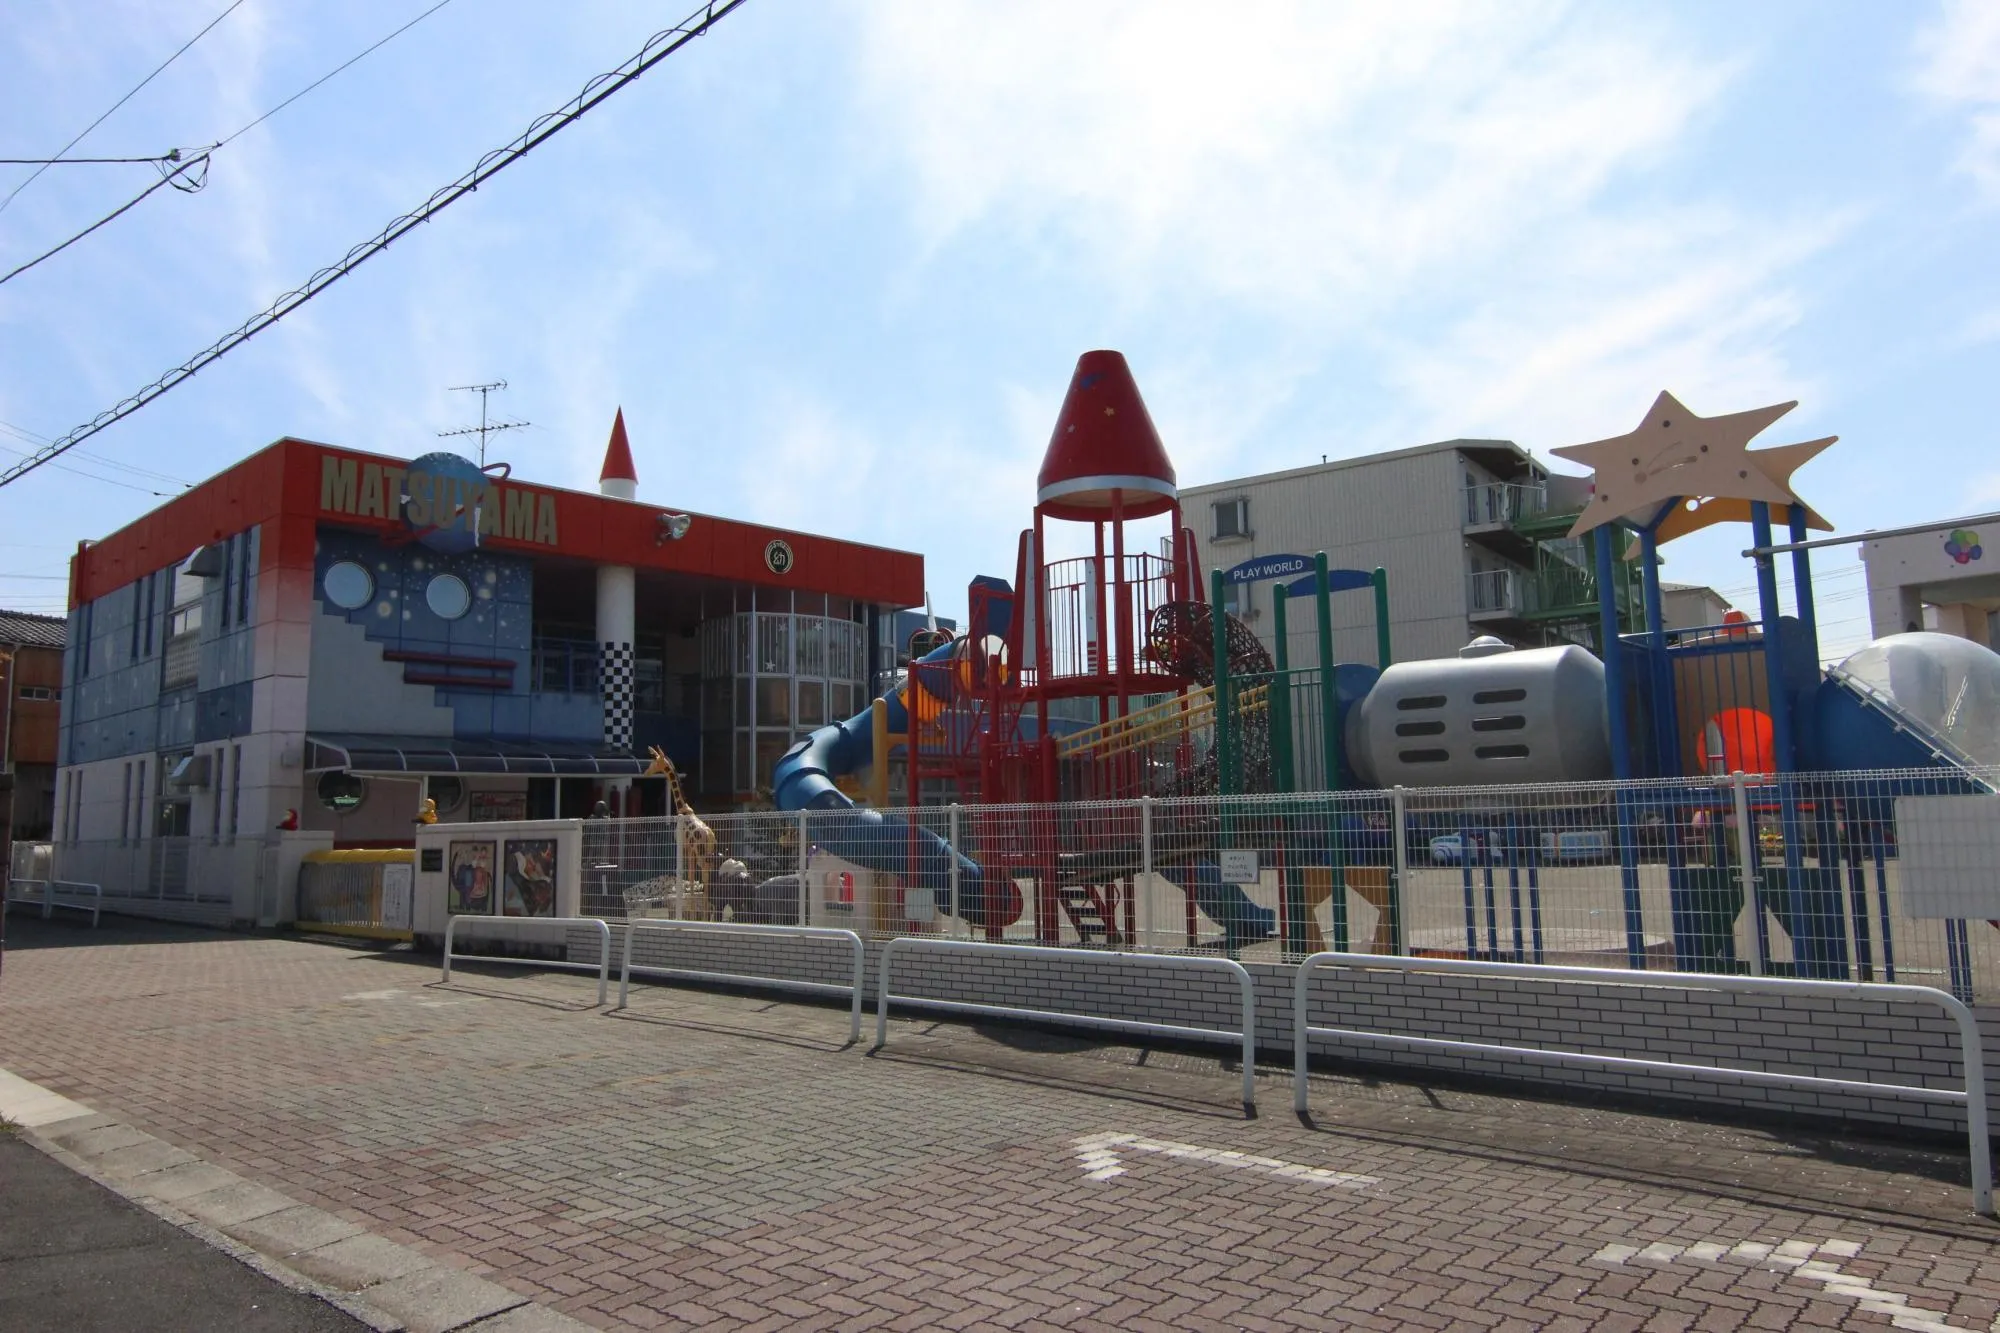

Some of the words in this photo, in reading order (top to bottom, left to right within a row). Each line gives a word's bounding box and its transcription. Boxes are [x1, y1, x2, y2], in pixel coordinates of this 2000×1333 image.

[320, 454, 558, 546] MATSUYAMA
[1233, 567, 1260, 580] PLAY
[1263, 560, 1303, 575] WORLD
